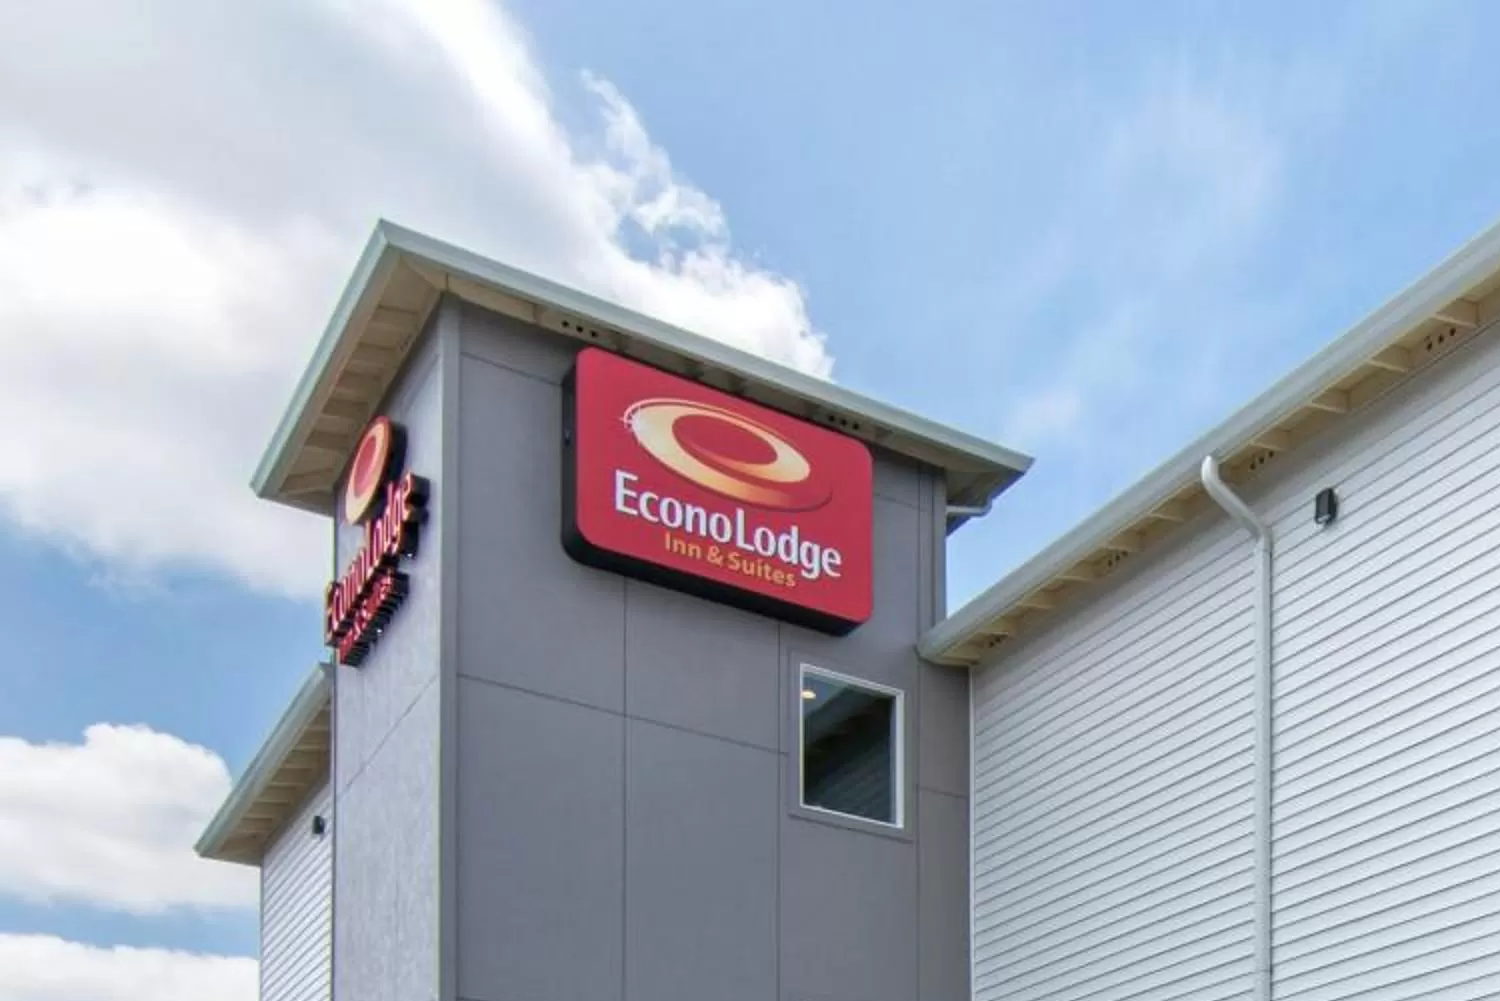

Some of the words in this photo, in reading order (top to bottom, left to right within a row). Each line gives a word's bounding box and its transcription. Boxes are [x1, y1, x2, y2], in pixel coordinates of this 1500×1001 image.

[614, 469, 843, 579] EconoLodge
[664, 531, 702, 560] Inn
[706, 543, 725, 567] &
[727, 551, 798, 588] Suites
